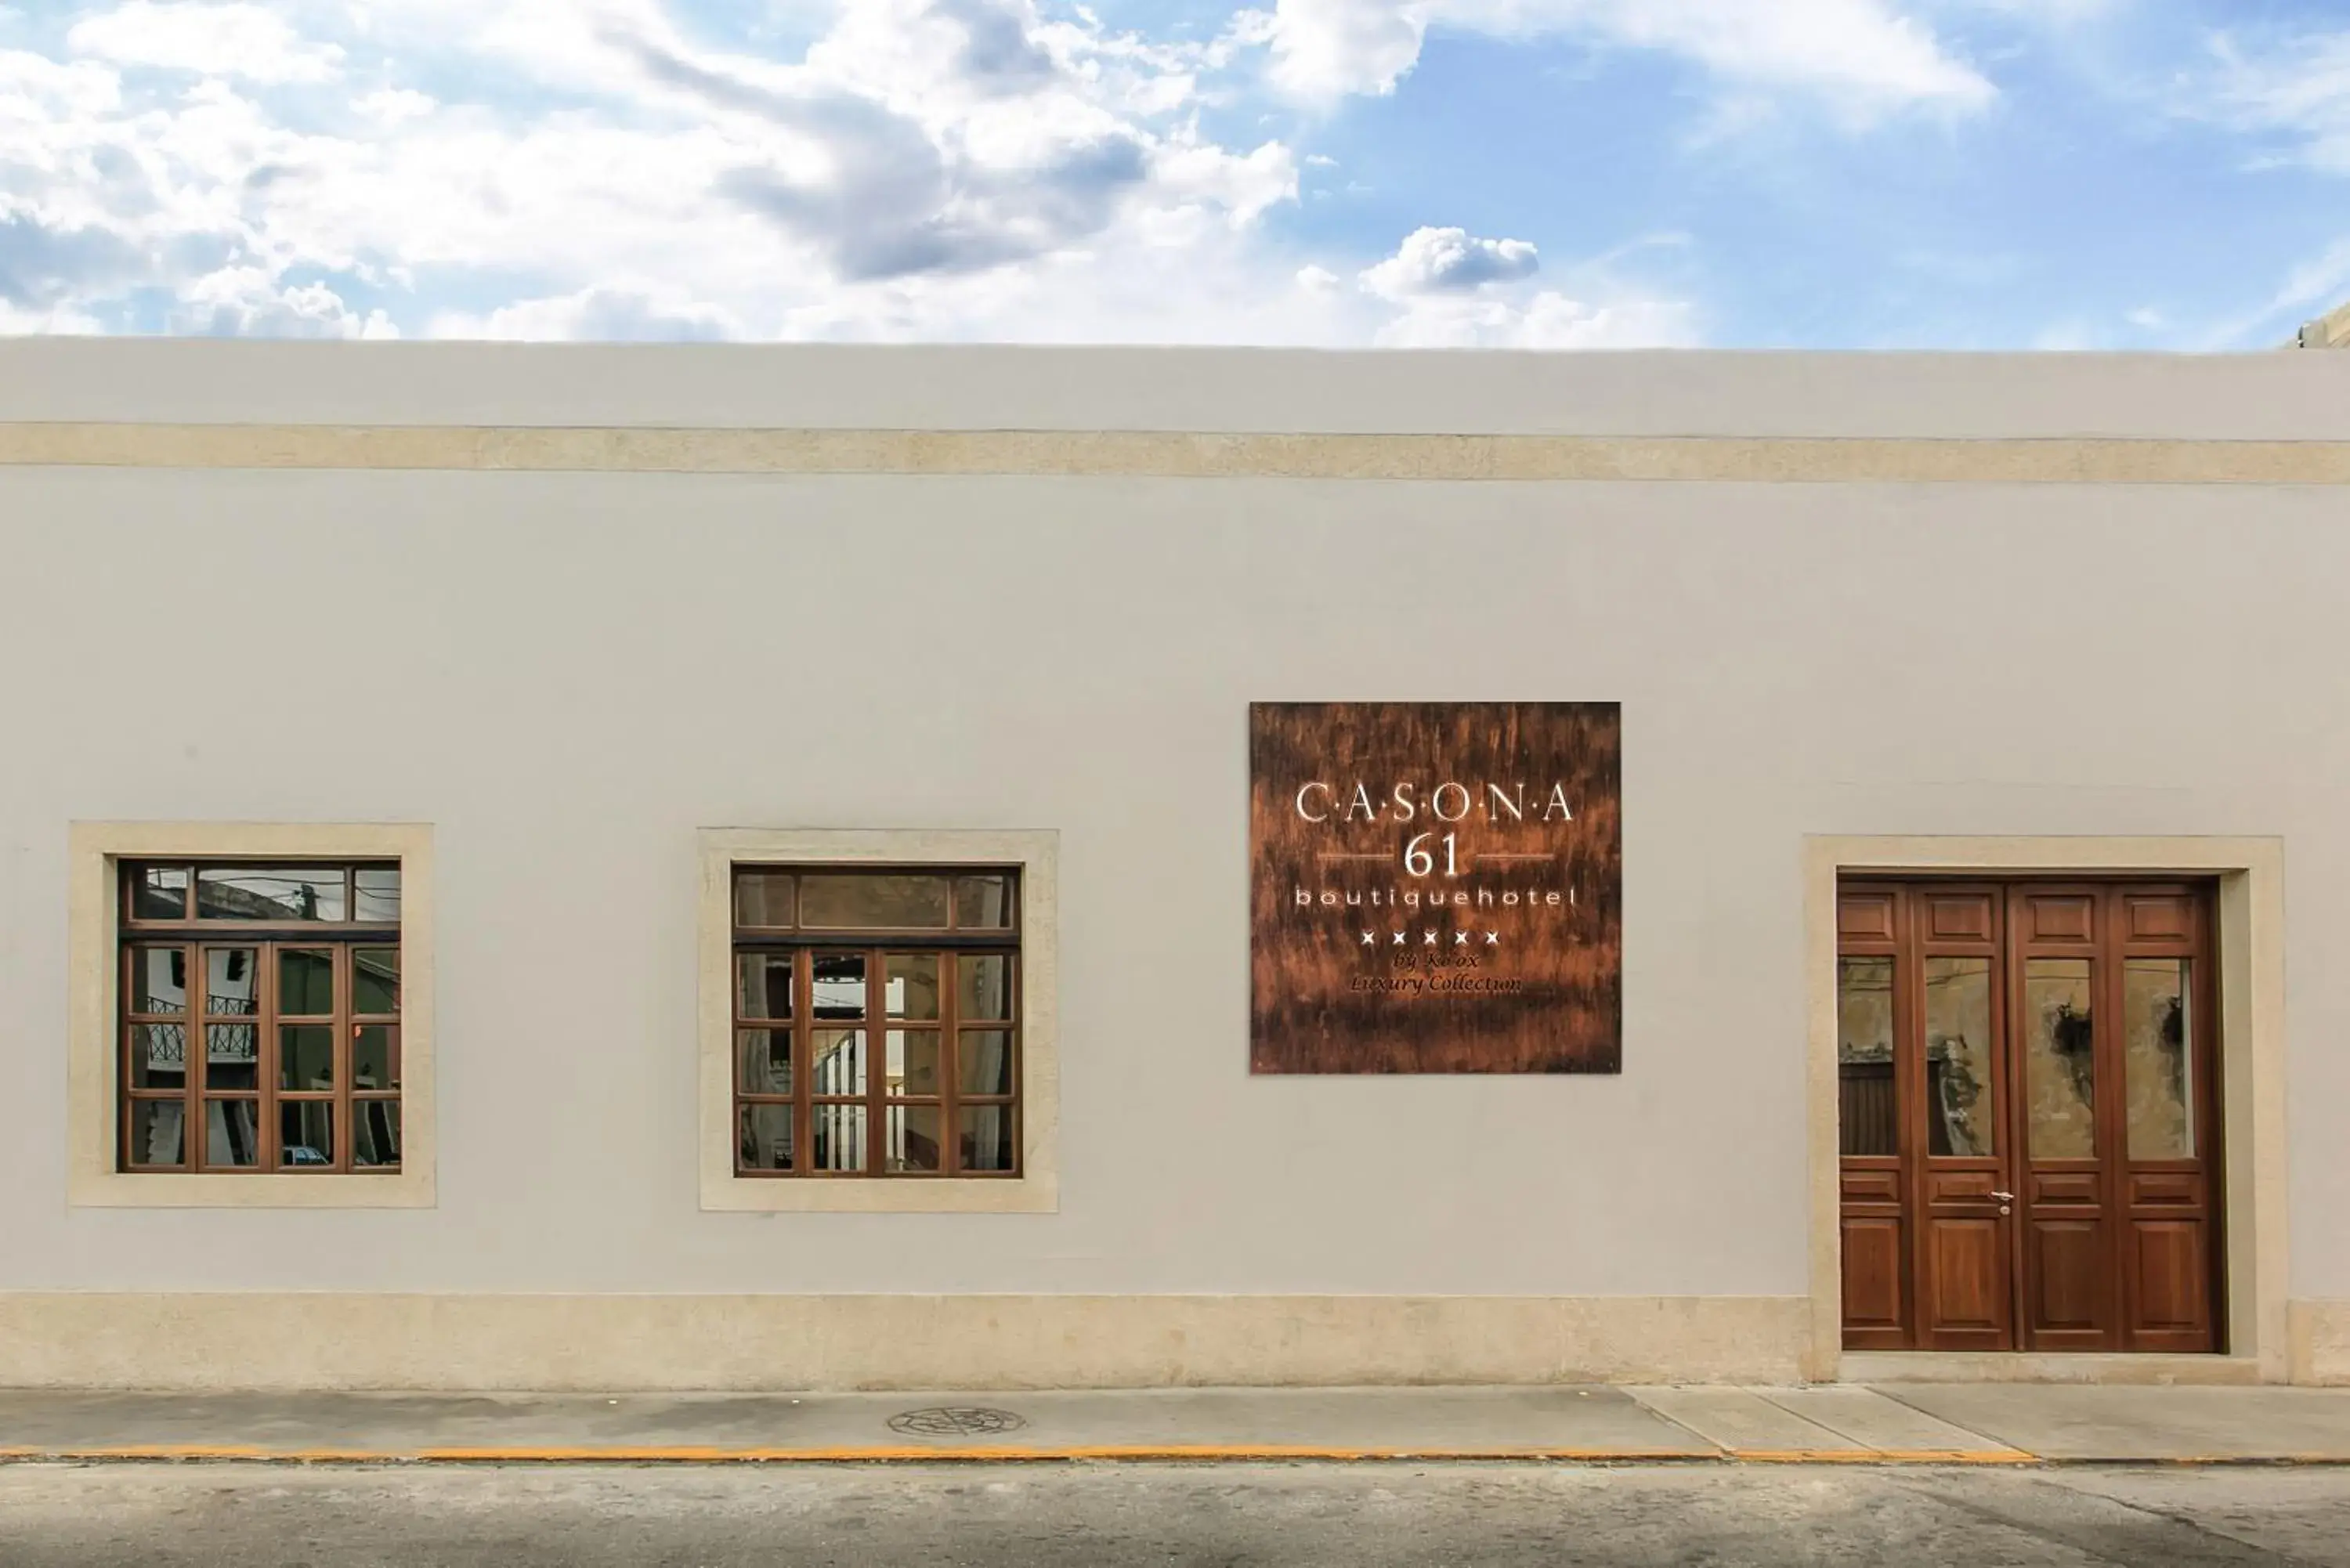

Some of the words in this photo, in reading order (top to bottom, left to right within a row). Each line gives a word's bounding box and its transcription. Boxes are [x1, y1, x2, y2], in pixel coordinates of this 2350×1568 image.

[1404, 831, 1458, 877] 61
[1392, 951, 1417, 971] by
[1350, 975, 1424, 995] Luxury
[1428, 974, 1522, 992] Collection
